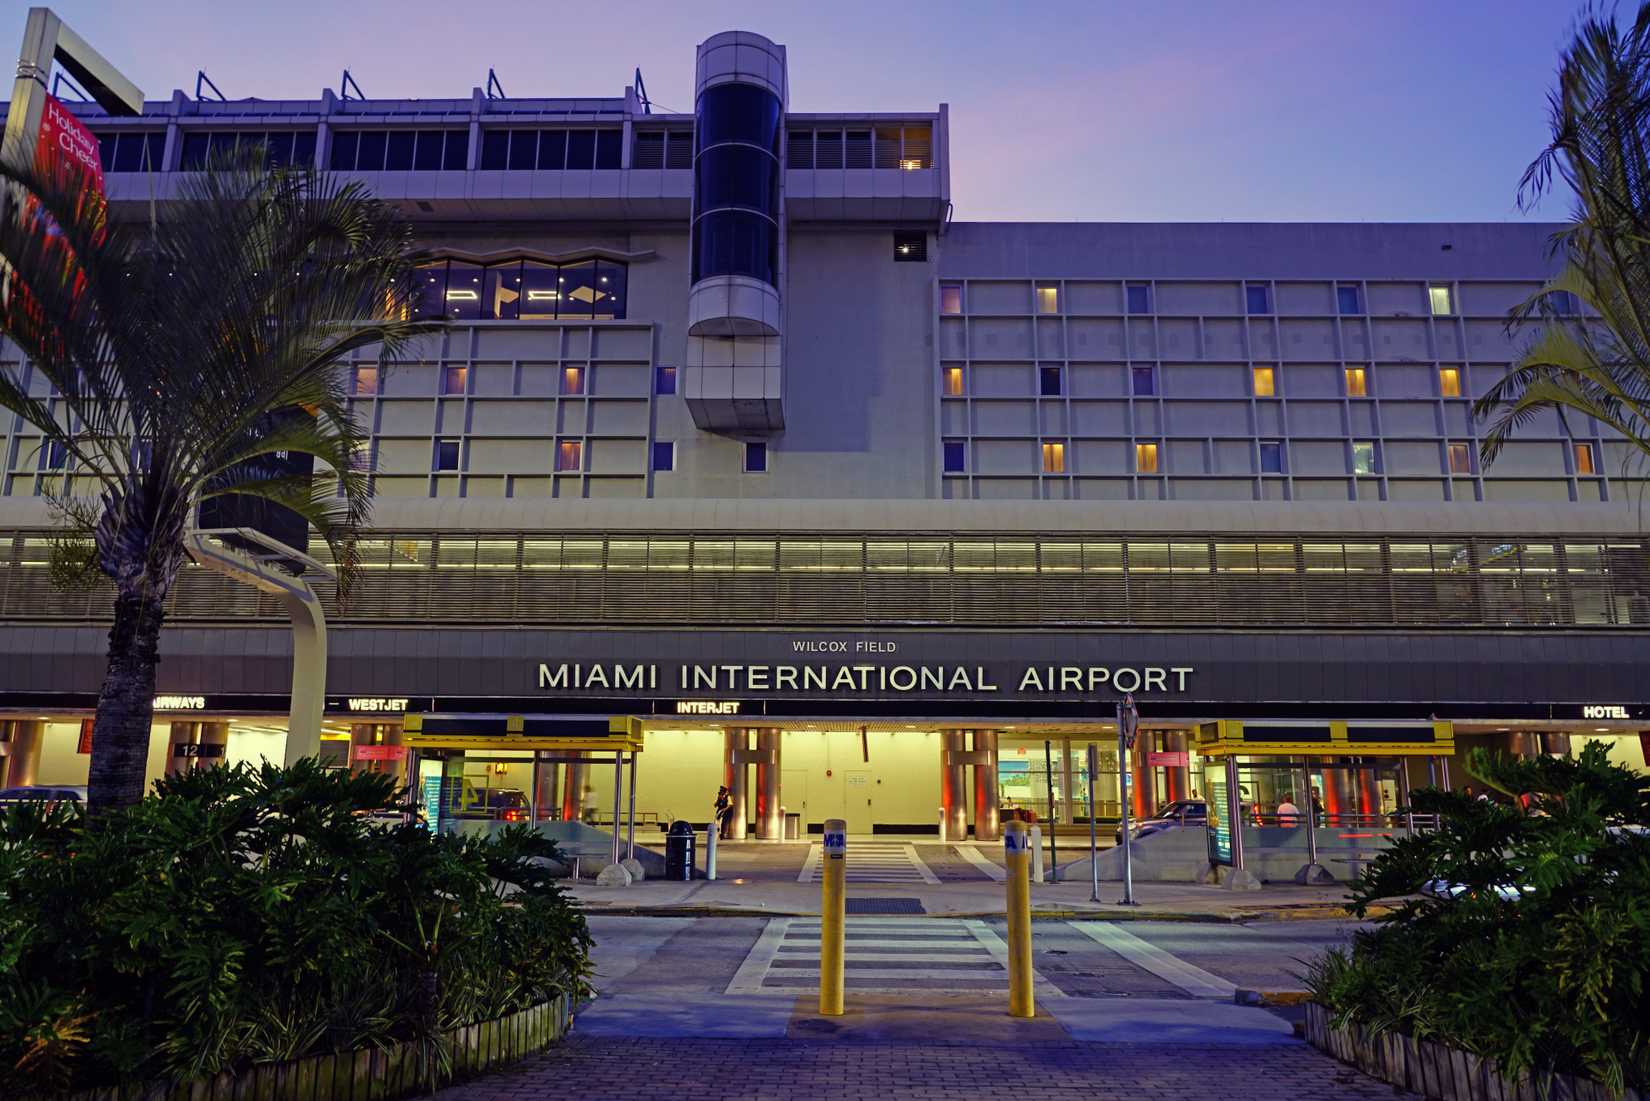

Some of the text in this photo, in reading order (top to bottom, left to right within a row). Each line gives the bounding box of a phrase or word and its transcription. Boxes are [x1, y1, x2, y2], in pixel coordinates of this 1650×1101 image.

[48, 104, 95, 155] Holiday
[59, 132, 97, 170] Cheer
[792, 640, 897, 653] WILCOX FIELD
[538, 663, 1194, 692] MIAMI INTERNATIONAL AIRPORT
[348, 698, 409, 711] WESTJET
[677, 701, 740, 714] INTERJET
[1583, 705, 1630, 719] HOTEL
[182, 744, 198, 757] 12
